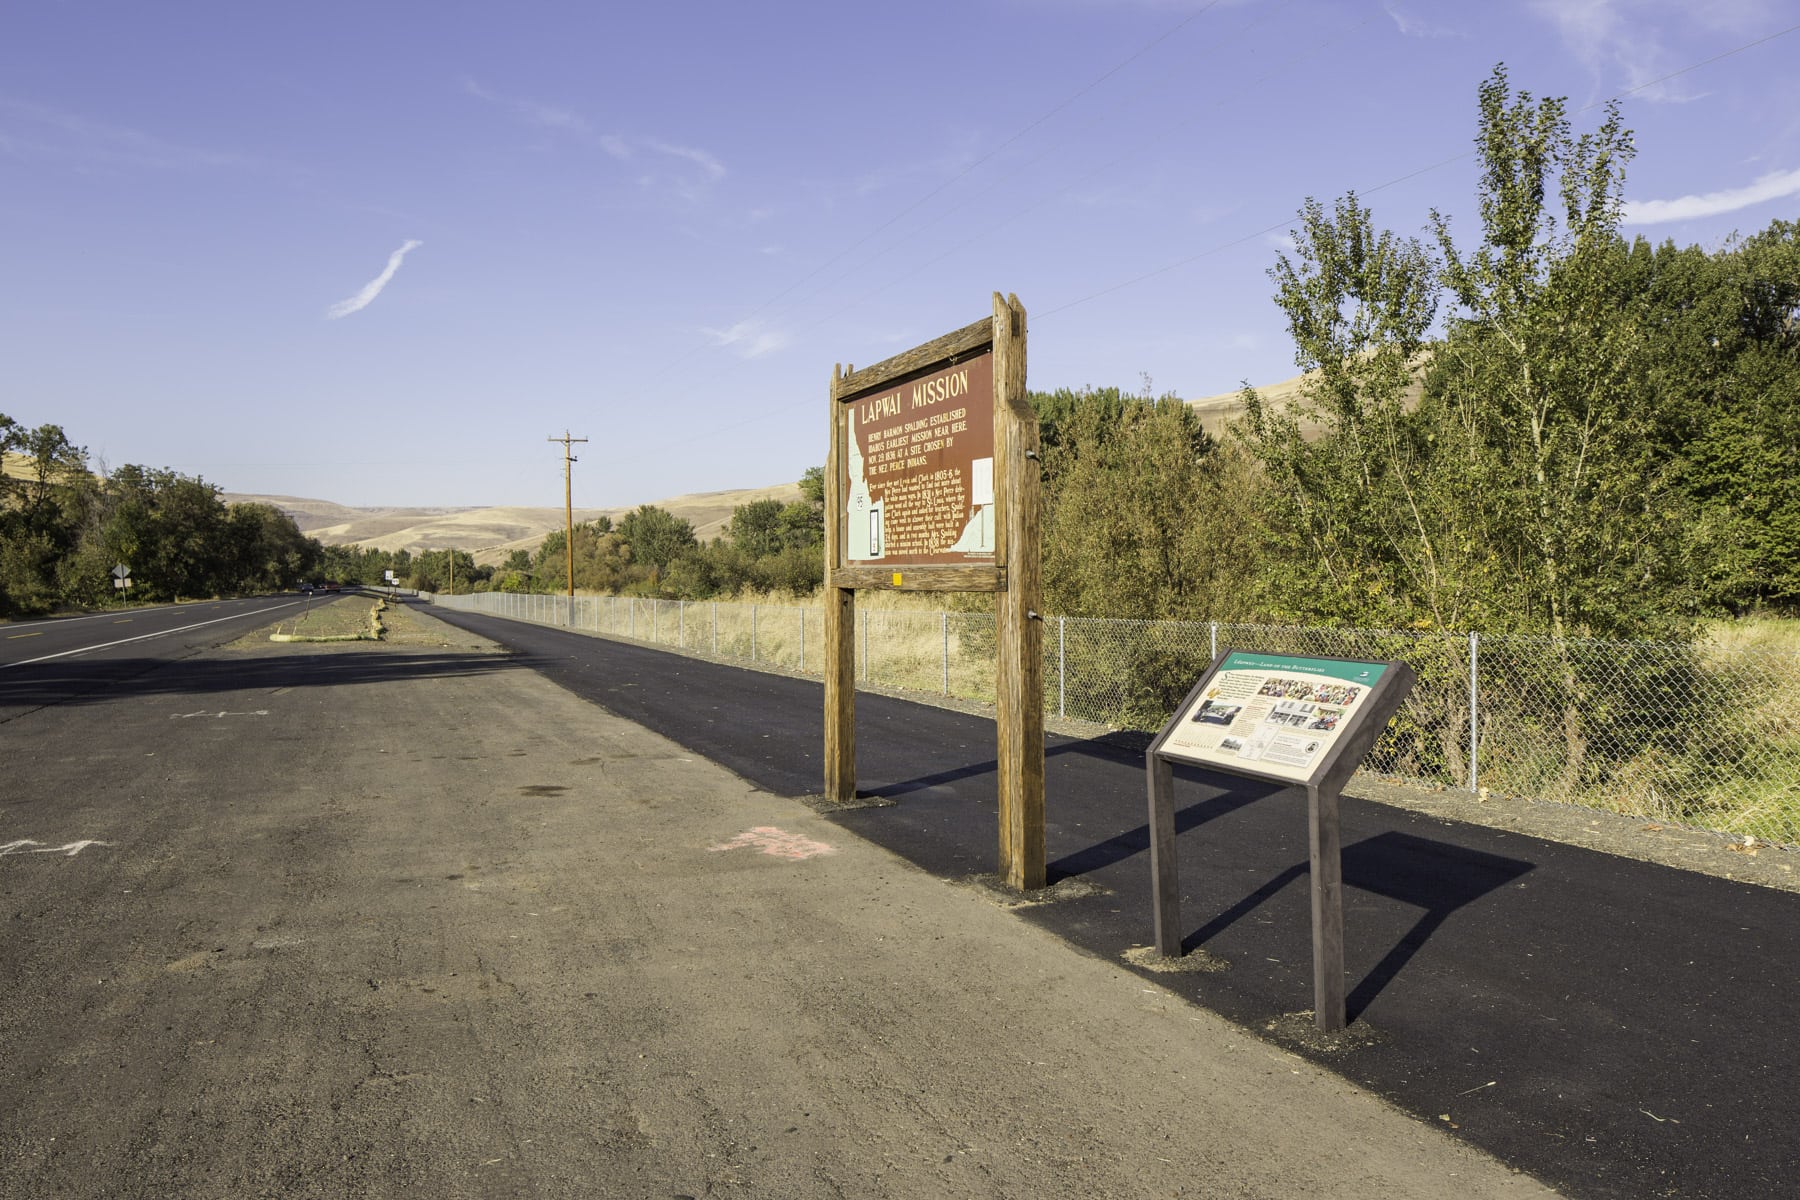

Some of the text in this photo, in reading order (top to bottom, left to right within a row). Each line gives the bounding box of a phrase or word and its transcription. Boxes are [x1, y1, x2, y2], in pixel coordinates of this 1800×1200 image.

[862, 370, 968, 424] LAPWAI MISSION
[868, 432, 881, 442] HENRY
[905, 418, 928, 433] SPALDING
[930, 408, 966, 426] ESTABLISHED
[887, 436, 908, 449] EARLIEST
[911, 430, 932, 443] MISSION
[935, 425, 949, 437] NEAR
[897, 449, 902, 457] AT
[905, 448, 908, 456] A
[911, 445, 921, 455] SITE
[924, 439, 944, 452] CHOSEN
[947, 437, 953, 447] BY
[869, 466, 877, 475] THE
[879, 464, 887, 473] NEZ
[890, 460, 905, 471] PERCE
